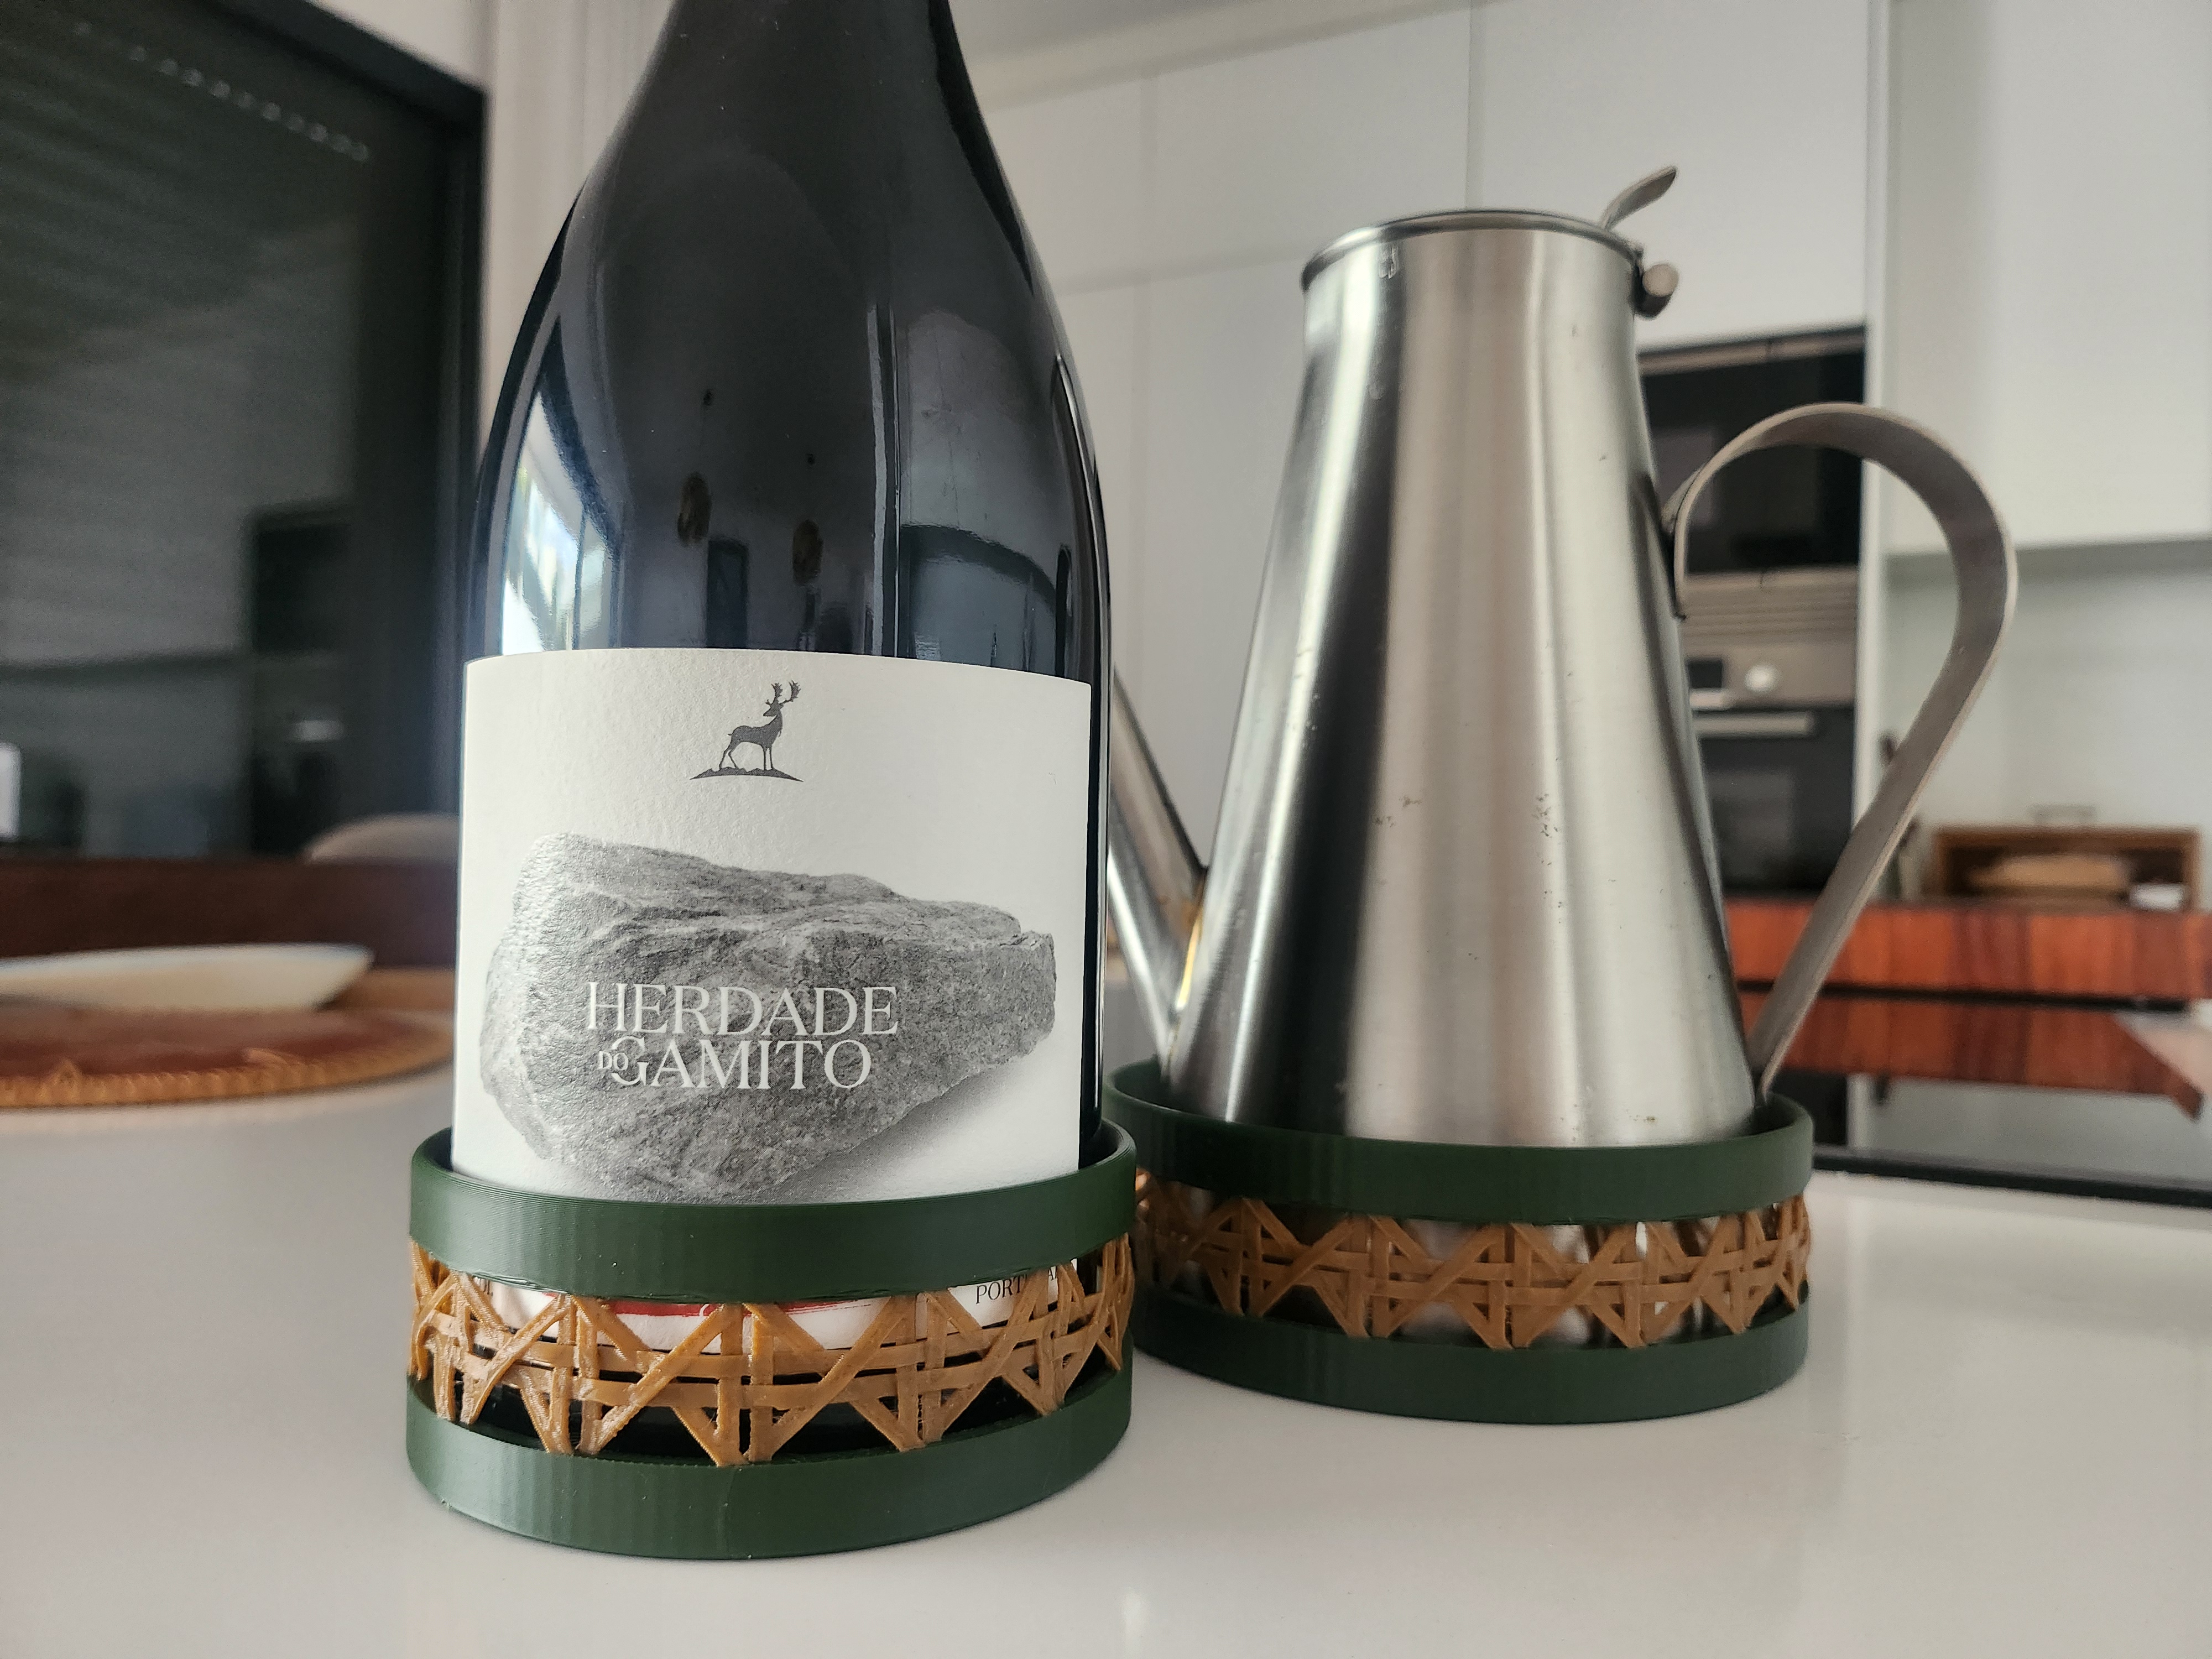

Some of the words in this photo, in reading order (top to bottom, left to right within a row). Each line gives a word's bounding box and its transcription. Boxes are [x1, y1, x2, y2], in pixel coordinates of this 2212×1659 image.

[587, 982, 899, 1036] HERDADE
[598, 1051, 629, 1071] DO
[611, 1036, 872, 1089] GAMITO
